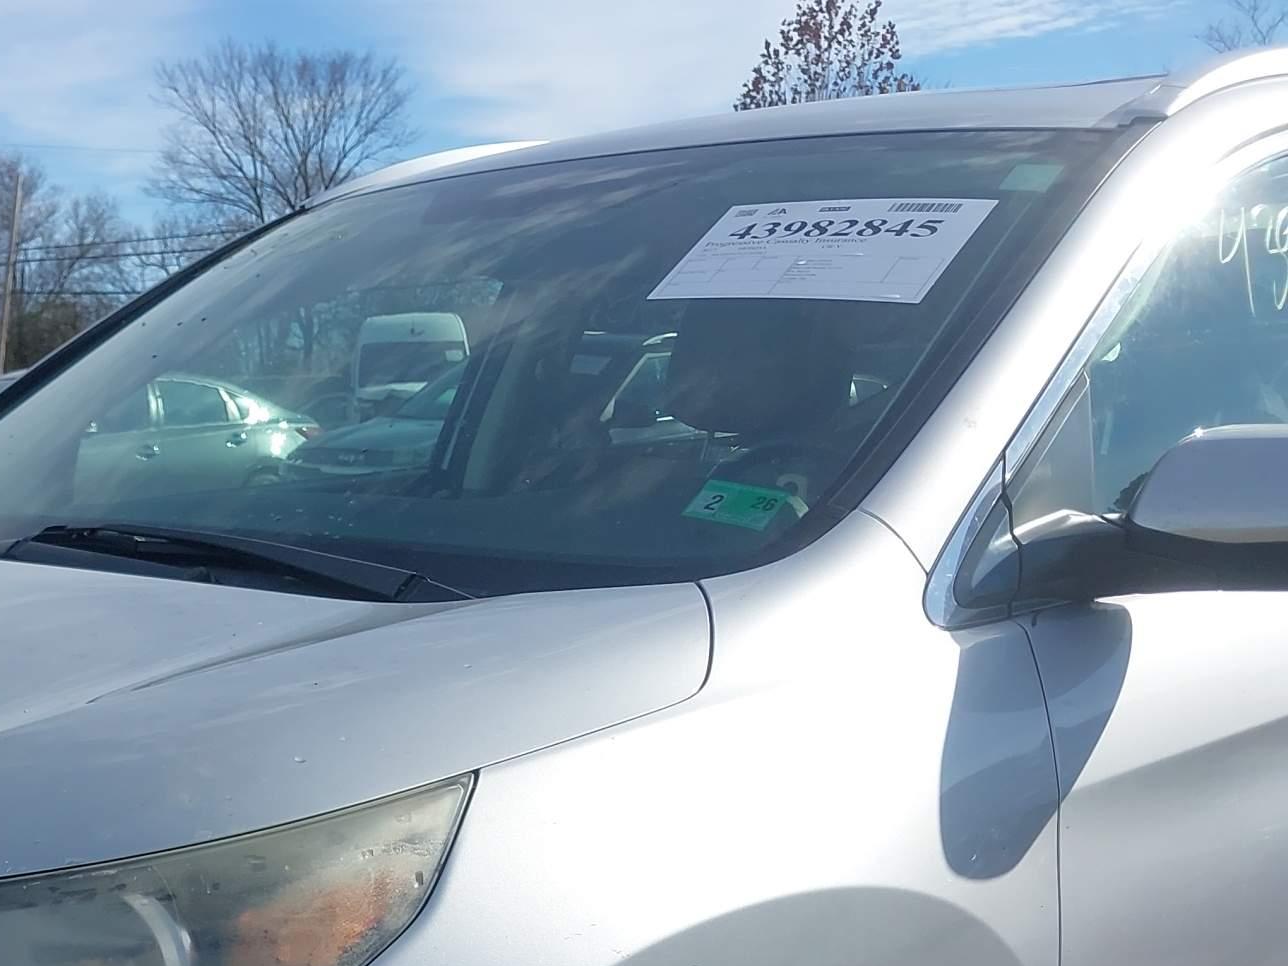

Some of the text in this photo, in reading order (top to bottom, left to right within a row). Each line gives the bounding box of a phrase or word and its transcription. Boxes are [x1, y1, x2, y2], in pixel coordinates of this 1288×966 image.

[729, 219, 945, 240] 43982845
[704, 495, 778, 512] 2 26
